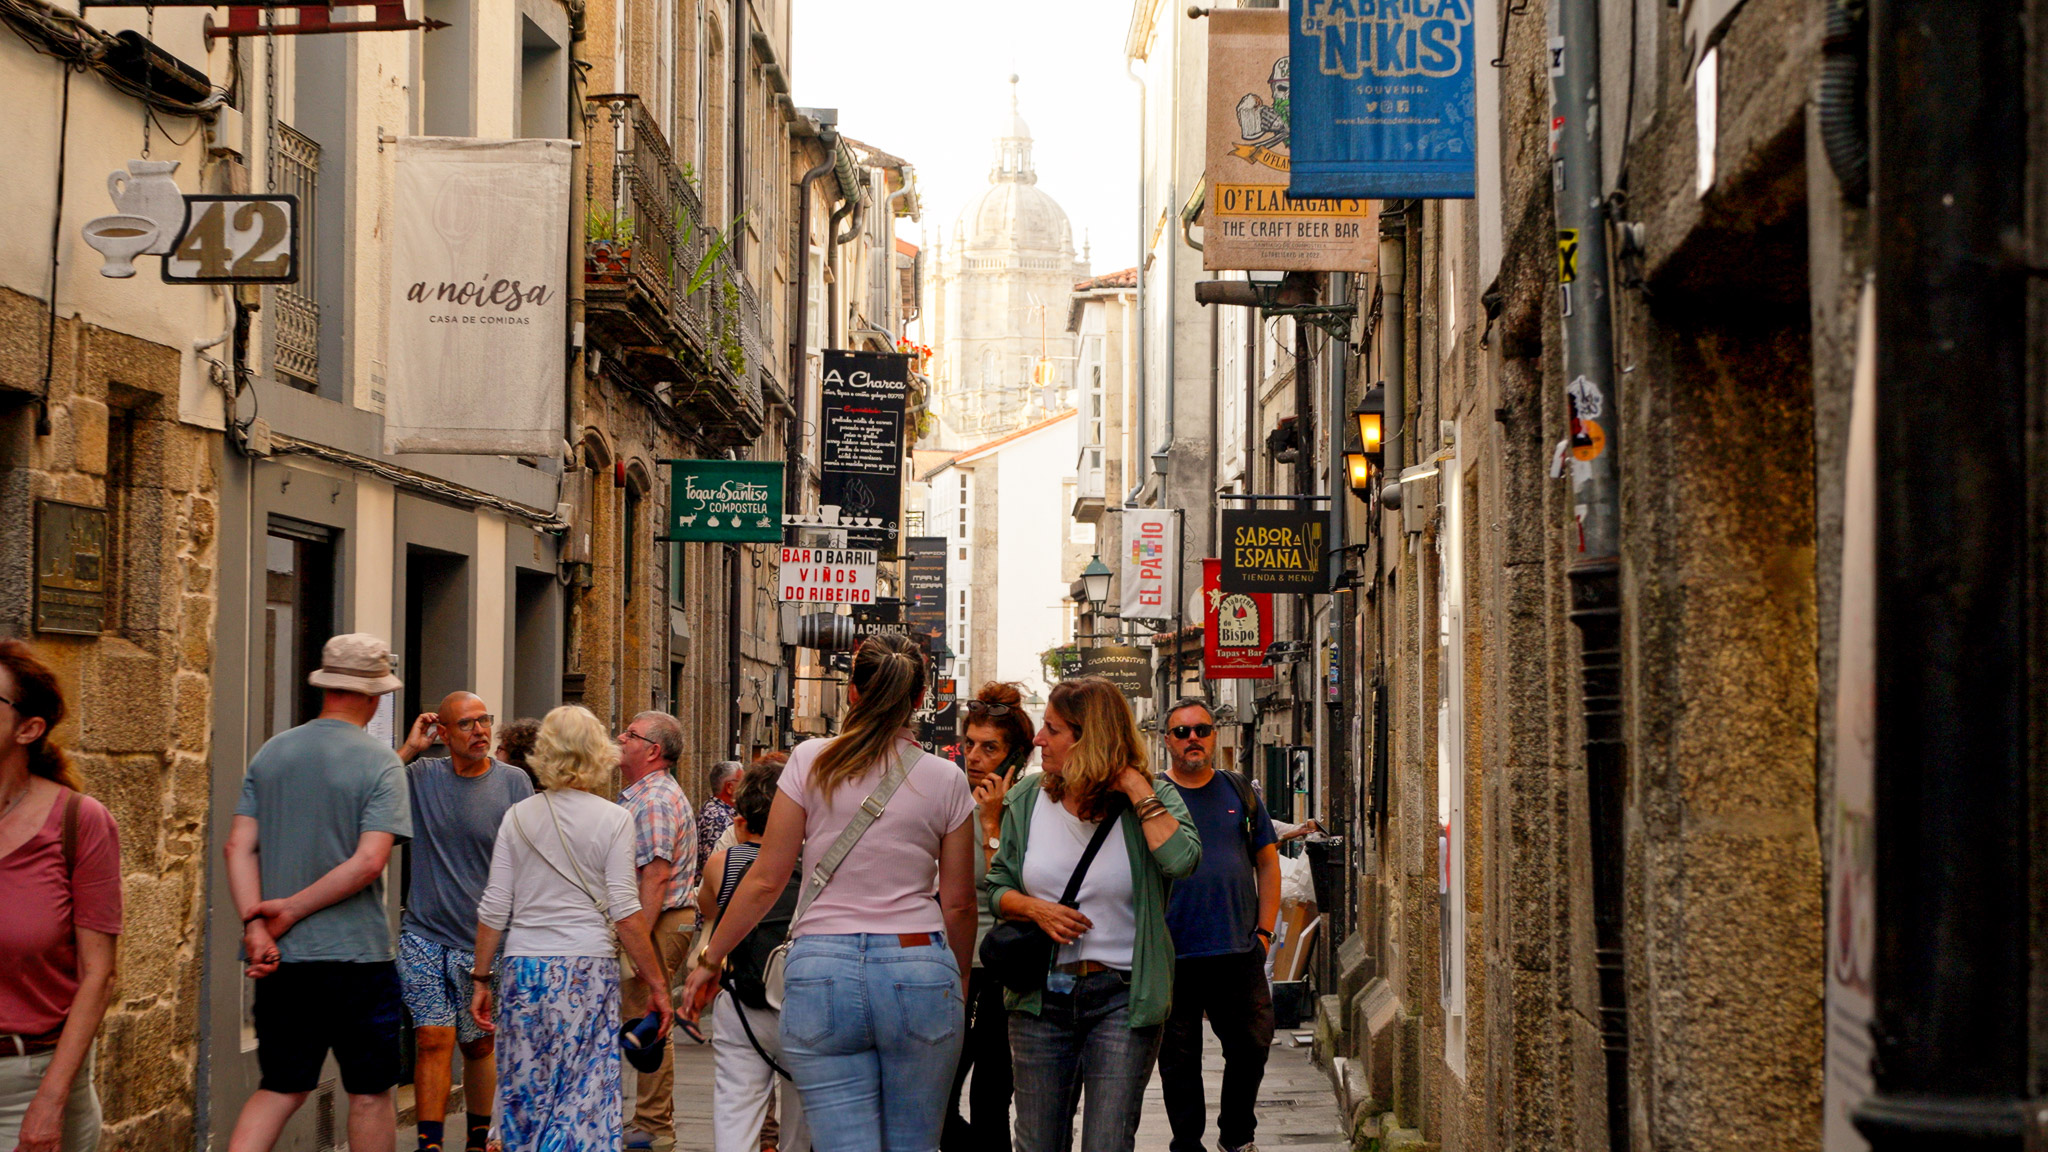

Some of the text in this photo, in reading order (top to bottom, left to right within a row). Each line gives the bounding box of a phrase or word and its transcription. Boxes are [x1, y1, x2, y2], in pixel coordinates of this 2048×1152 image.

[1306, 19, 1324, 31] DE
[1325, 20, 1456, 74] NIKIS
[1357, 85, 1424, 95] SOUVENIR
[1224, 188, 1360, 212] O'FLANAGANS
[1223, 221, 1360, 238] THE CRAFT BEER BAR
[177, 201, 290, 278] 42
[407, 273, 555, 312] a noiesa
[429, 315, 530, 325] CASA DE COMIDAS
[824, 369, 906, 389] A Charca
[684, 475, 717, 511] Fogar
[720, 479, 768, 503] Santiso
[709, 502, 768, 514] COMPOSTELA
[1234, 526, 1302, 547] SABOR A
[782, 548, 876, 565] BAR O BARRIL
[1234, 547, 1302, 569] ESPAÑA
[799, 566, 857, 583] VIÑOS
[1242, 573, 1276, 582] TIENDA
[1279, 574, 1285, 582] &
[785, 586, 871, 603] DO RIBEIRO
[1139, 585, 1162, 606] EL
[866, 623, 907, 635] CHARCA
[1223, 619, 1232, 627] do
[1222, 628, 1255, 643] Bispo
[1216, 648, 1263, 659] Tapas Bar
